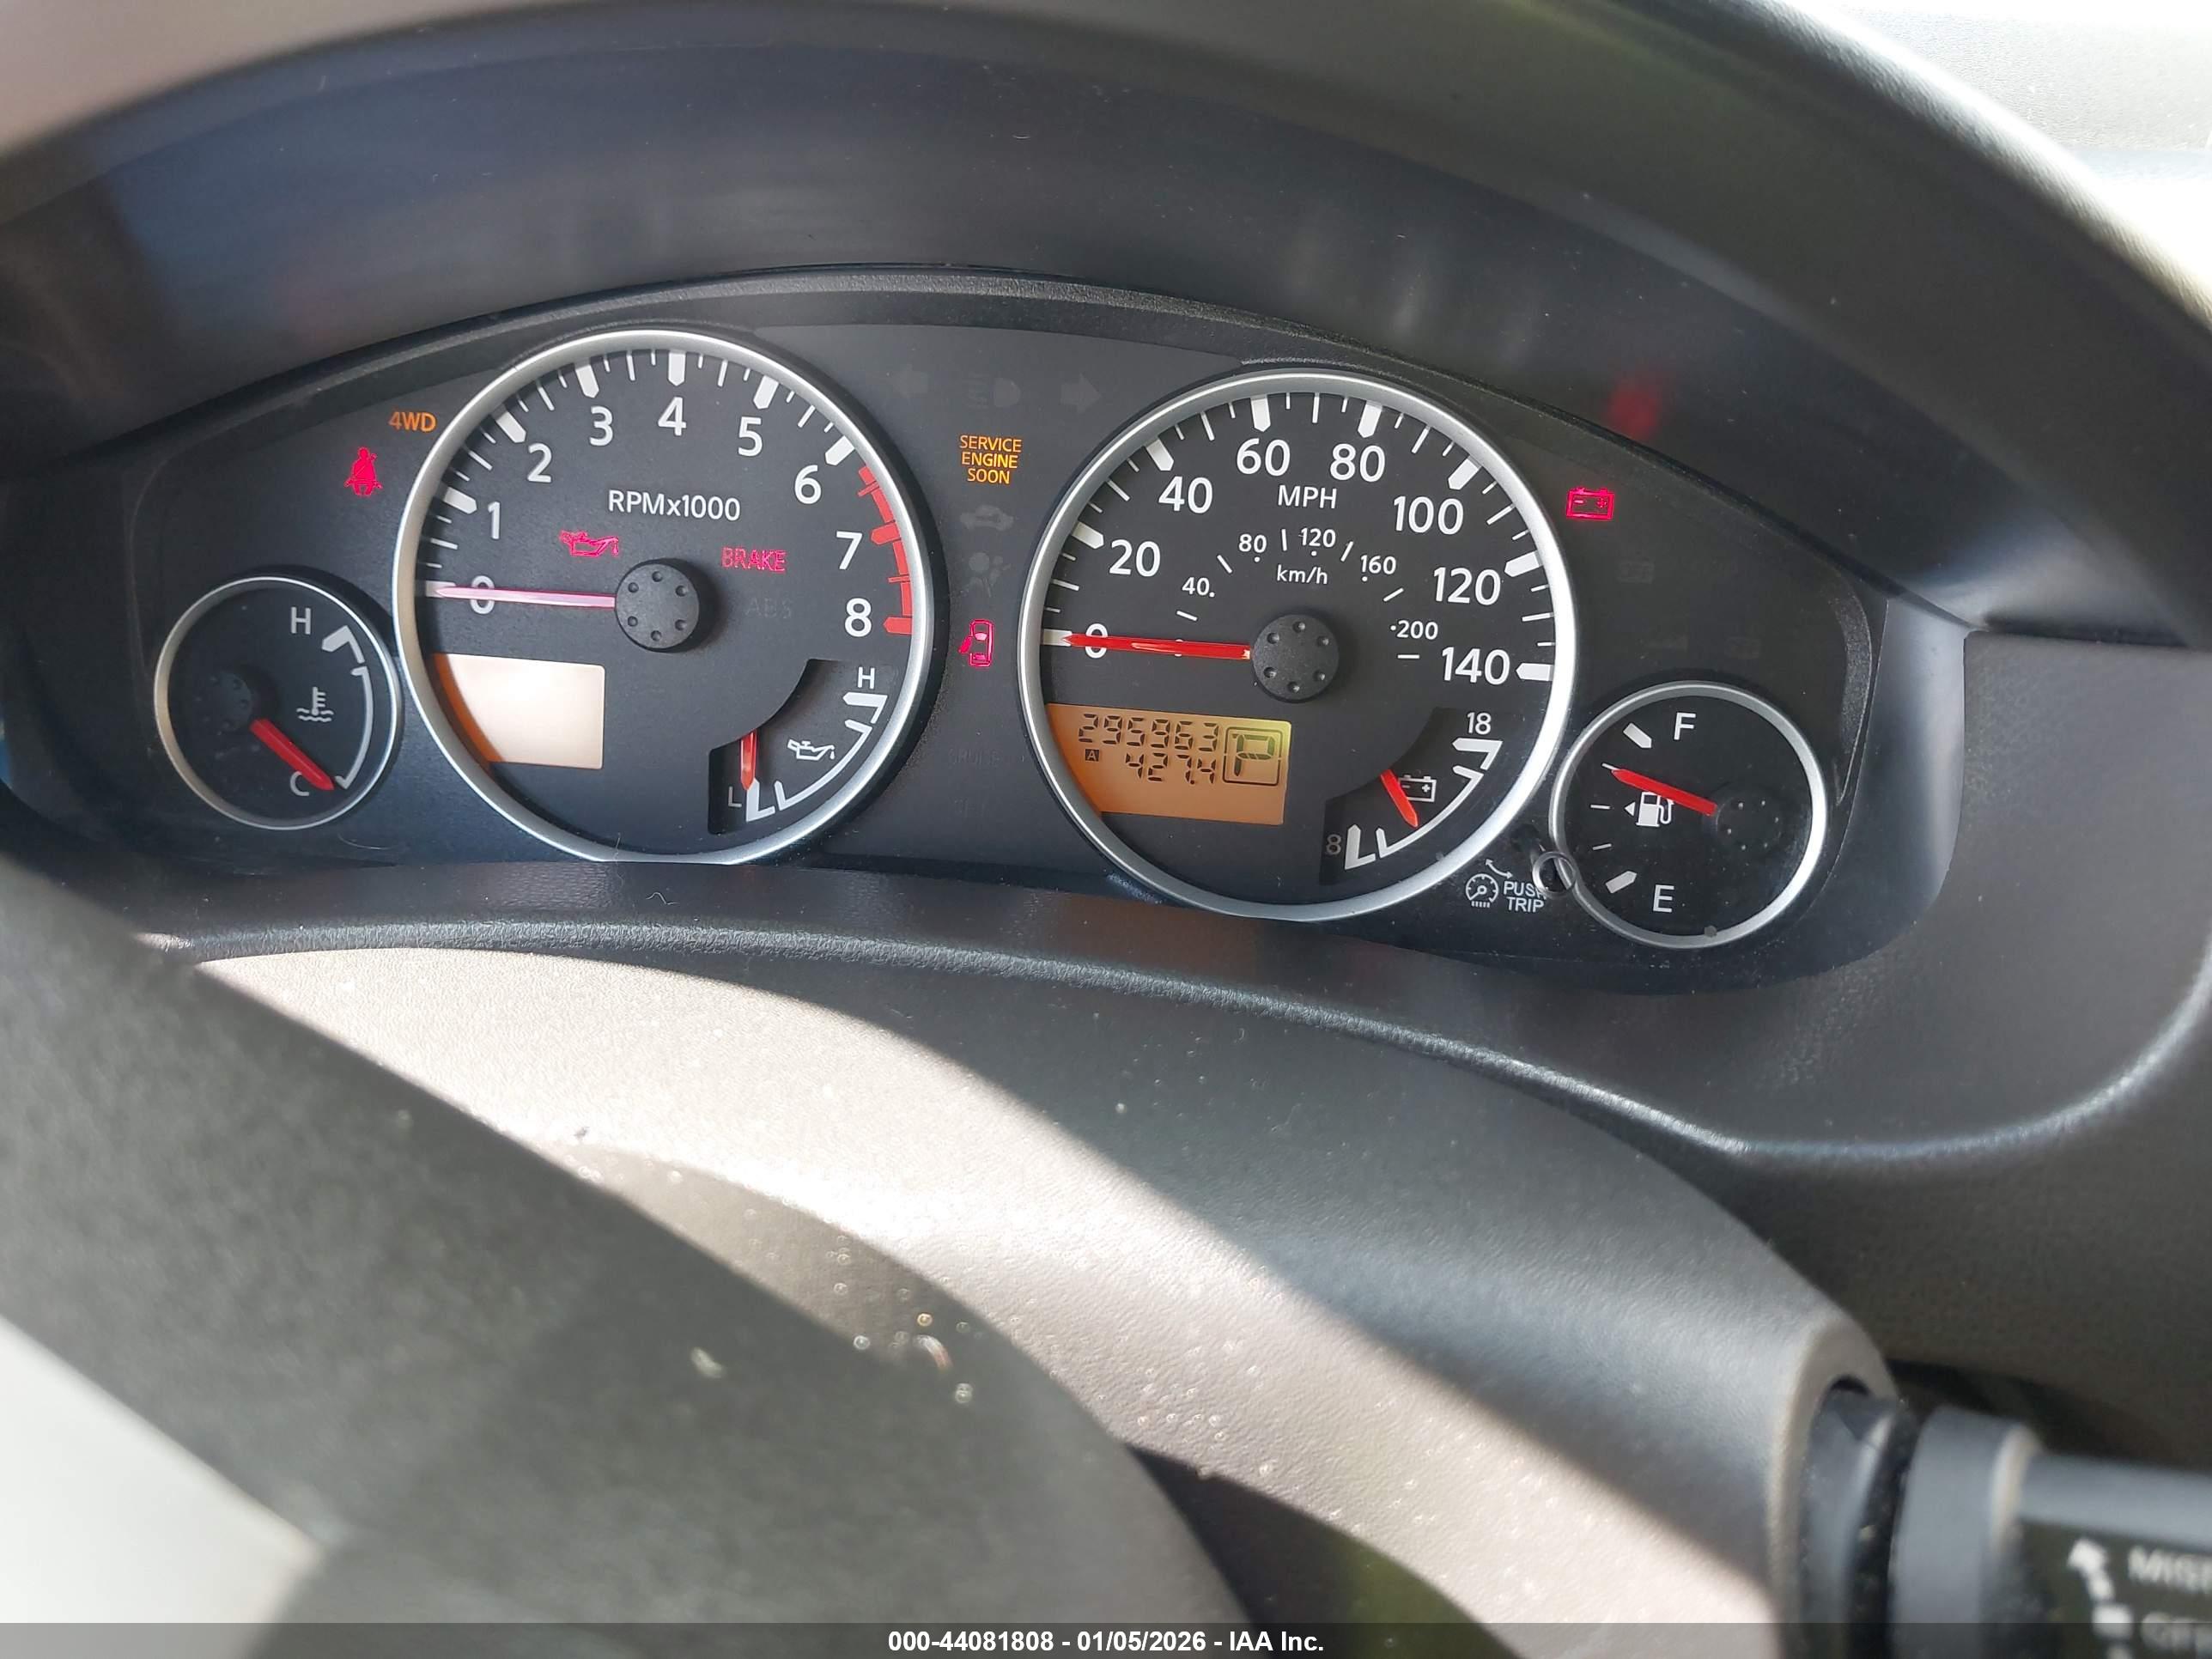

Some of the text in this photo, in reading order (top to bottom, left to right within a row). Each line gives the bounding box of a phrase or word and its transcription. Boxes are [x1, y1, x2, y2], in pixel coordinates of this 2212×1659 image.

[389, 412, 436, 432] 4WD
[589, 407, 613, 446] 3
[659, 397, 687, 436] 4
[738, 416, 763, 456] 5
[959, 434, 1022, 453] SERVICE
[527, 444, 552, 483] 2
[961, 452, 1018, 469] ENGINE
[1236, 438, 1291, 476] 60
[1329, 444, 1386, 482] 80
[794, 465, 822, 504] 6
[967, 468, 1011, 484] SOON
[608, 490, 740, 521] RPMx1000
[1158, 477, 1213, 514] 40
[1277, 485, 1337, 509] MPH
[487, 501, 501, 539] 1
[1393, 496, 1464, 535] 100
[836, 532, 863, 570] 7
[1238, 533, 1267, 554] 80
[1303, 528, 1336, 548] 120
[721, 548, 787, 572] BRAKE
[1109, 539, 1161, 577] 20
[1360, 555, 1397, 575] 160
[1182, 577, 1210, 596] 40
[1276, 565, 1328, 585] km/h
[1433, 568, 1501, 605] 120
[469, 576, 495, 615] 0
[290, 607, 312, 635] H
[844, 599, 872, 637] 8
[1396, 619, 1439, 641] 200
[1085, 623, 1109, 659] 0
[857, 666, 876, 690] H
[1441, 647, 1510, 685] 140
[1079, 714, 1219, 752] 295963
[1466, 712, 1492, 735] 18
[1673, 712, 1697, 740] F
[1125, 752, 1217, 785] 427.4
[1231, 732, 1276, 777] P
[289, 771, 310, 796] C
[727, 785, 742, 808] L
[1326, 834, 1342, 855] 8
[1506, 896, 1545, 913] TRIP
[1652, 884, 1674, 913] E
